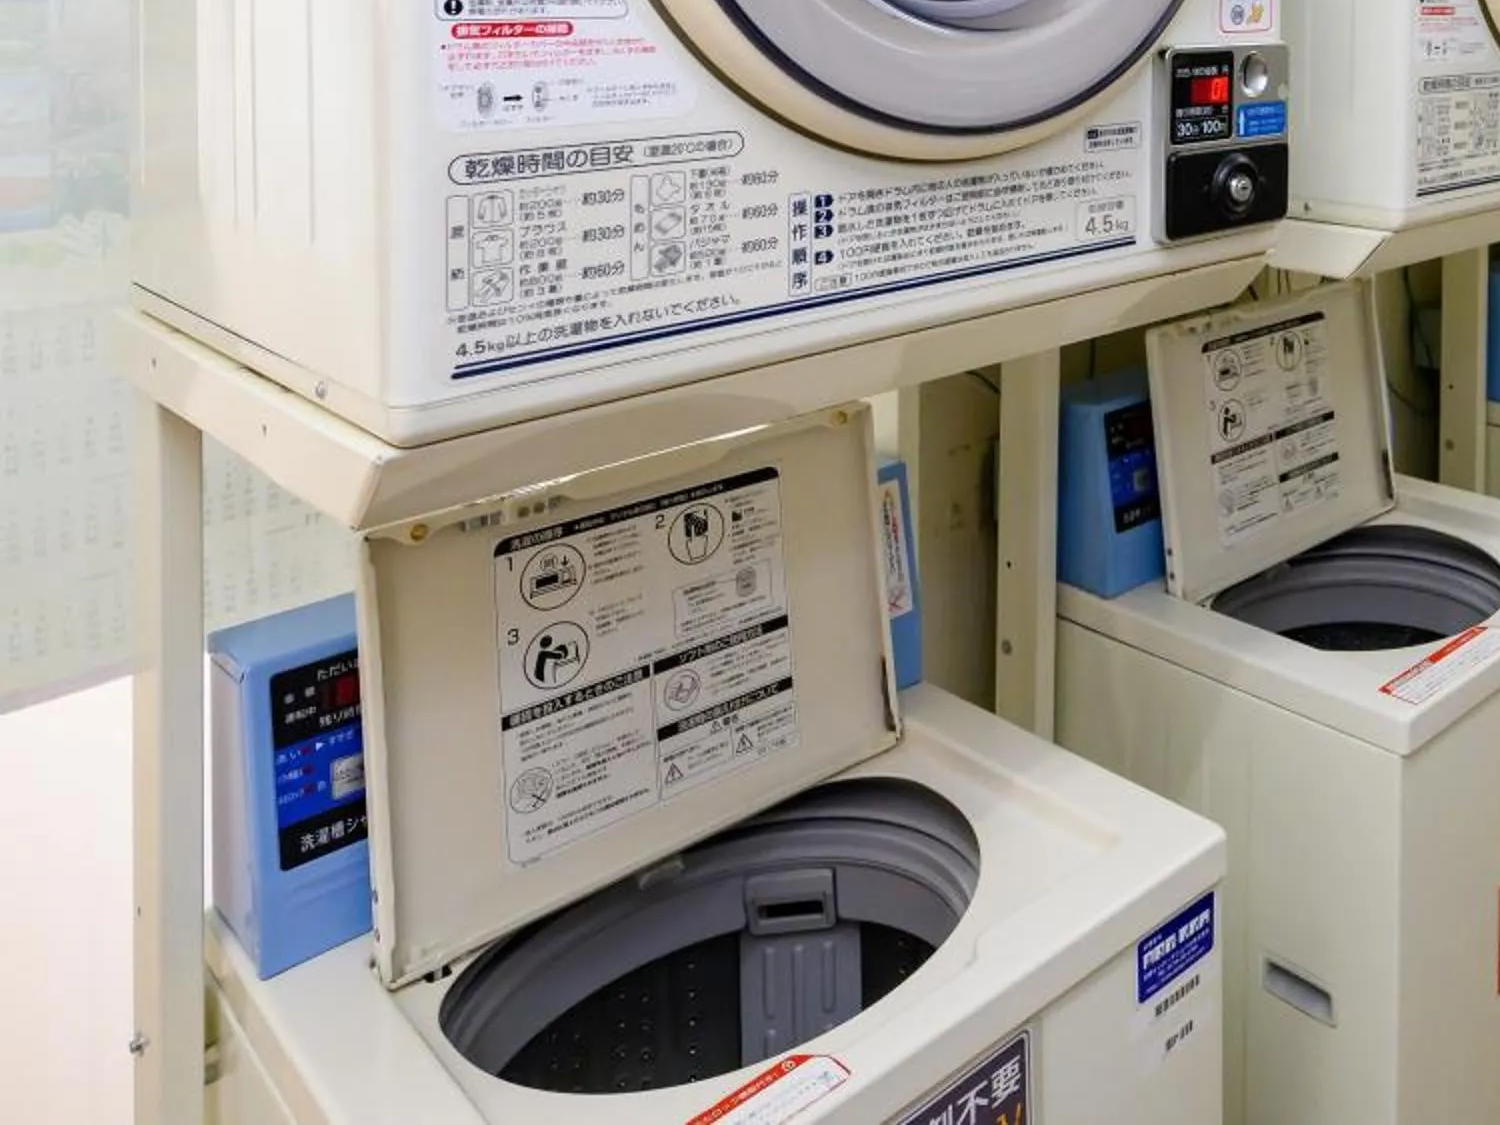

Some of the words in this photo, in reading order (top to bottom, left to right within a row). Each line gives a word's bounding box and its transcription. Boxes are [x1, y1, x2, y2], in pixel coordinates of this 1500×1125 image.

[464, 144, 634, 179] 乾燥時間の目安
[655, 514, 666, 530] 2
[506, 557, 515, 572] 1
[506, 628, 520, 645] 3
[317, 658, 358, 682] ただい
